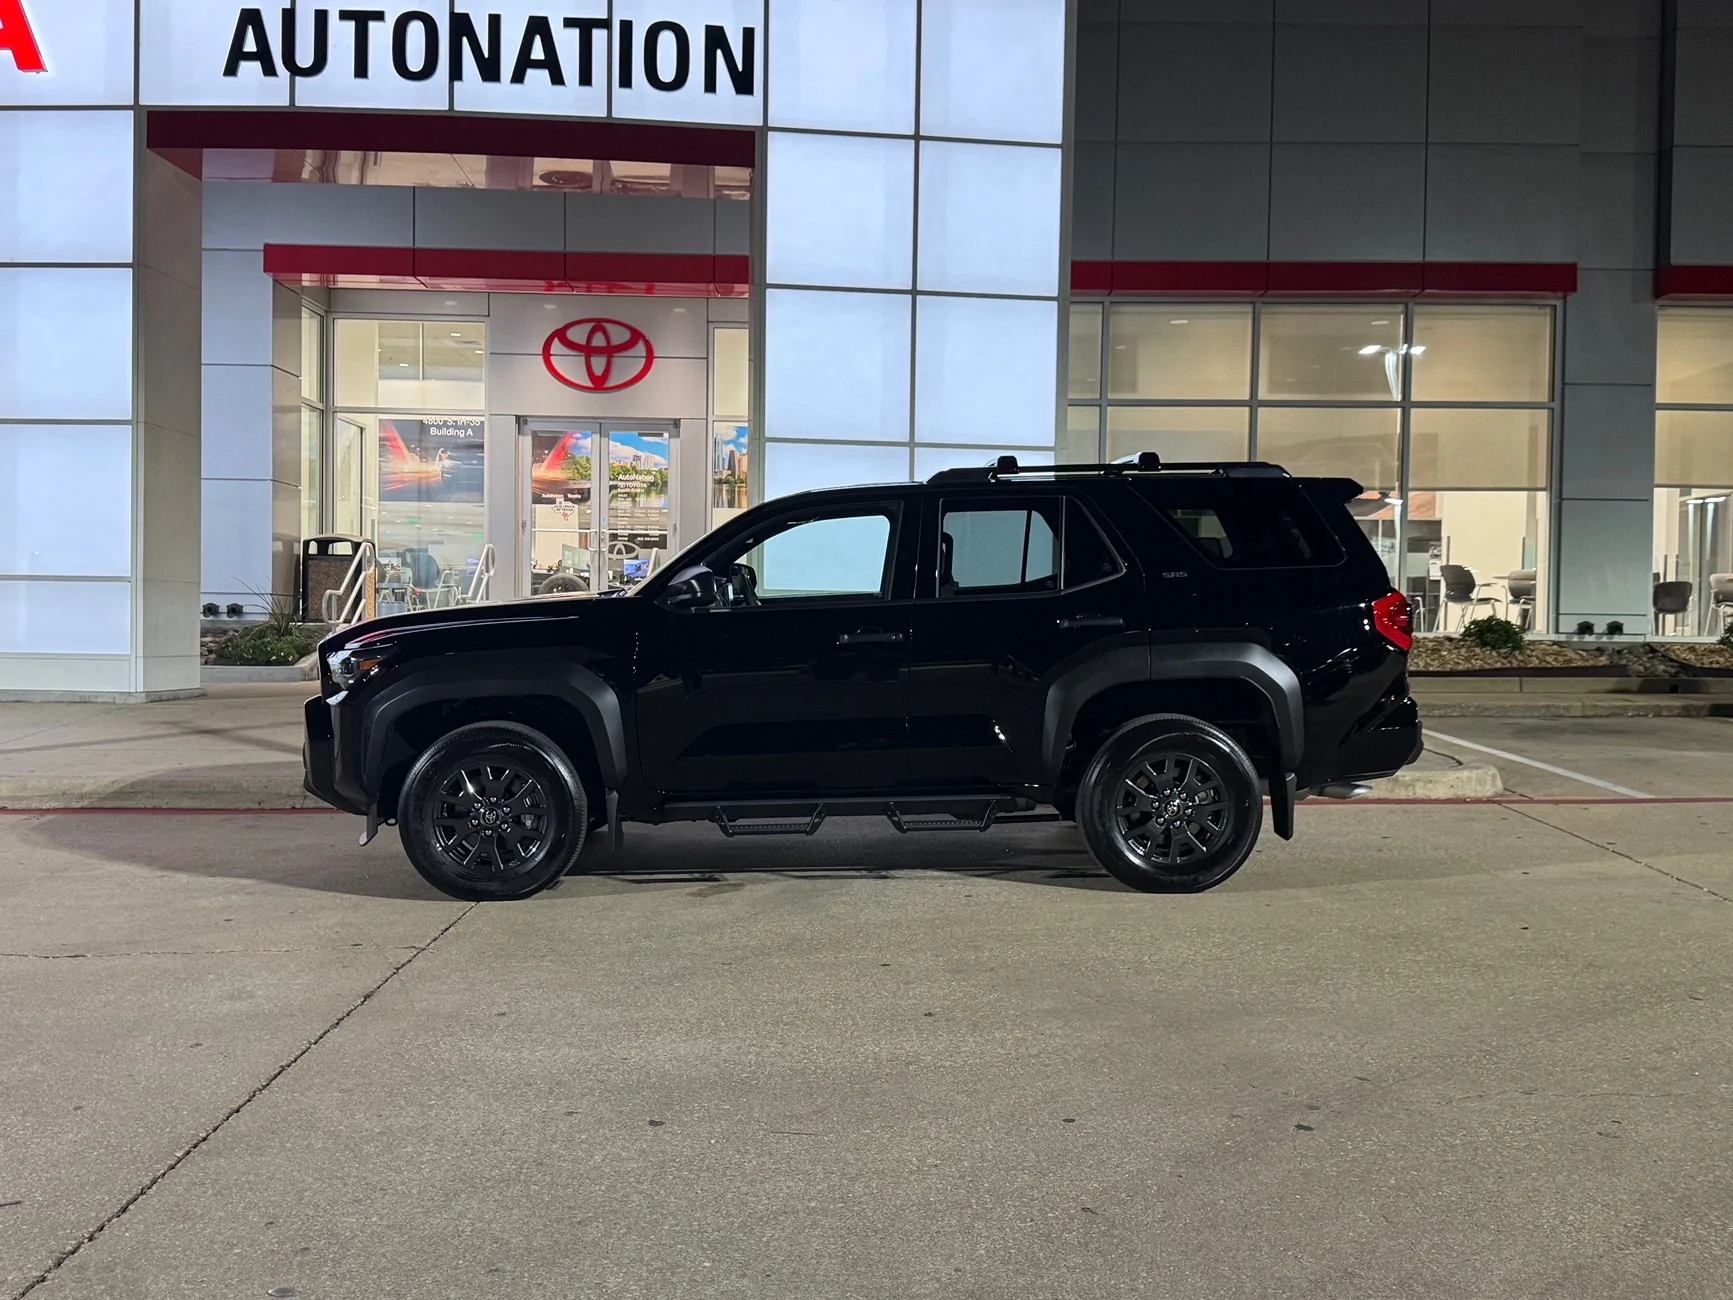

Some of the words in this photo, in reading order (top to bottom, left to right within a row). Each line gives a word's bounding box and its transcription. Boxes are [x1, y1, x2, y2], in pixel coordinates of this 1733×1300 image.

[222, 7, 756, 96] AUTONATION
[430, 427, 465, 437] Building
[466, 428, 474, 436] A
